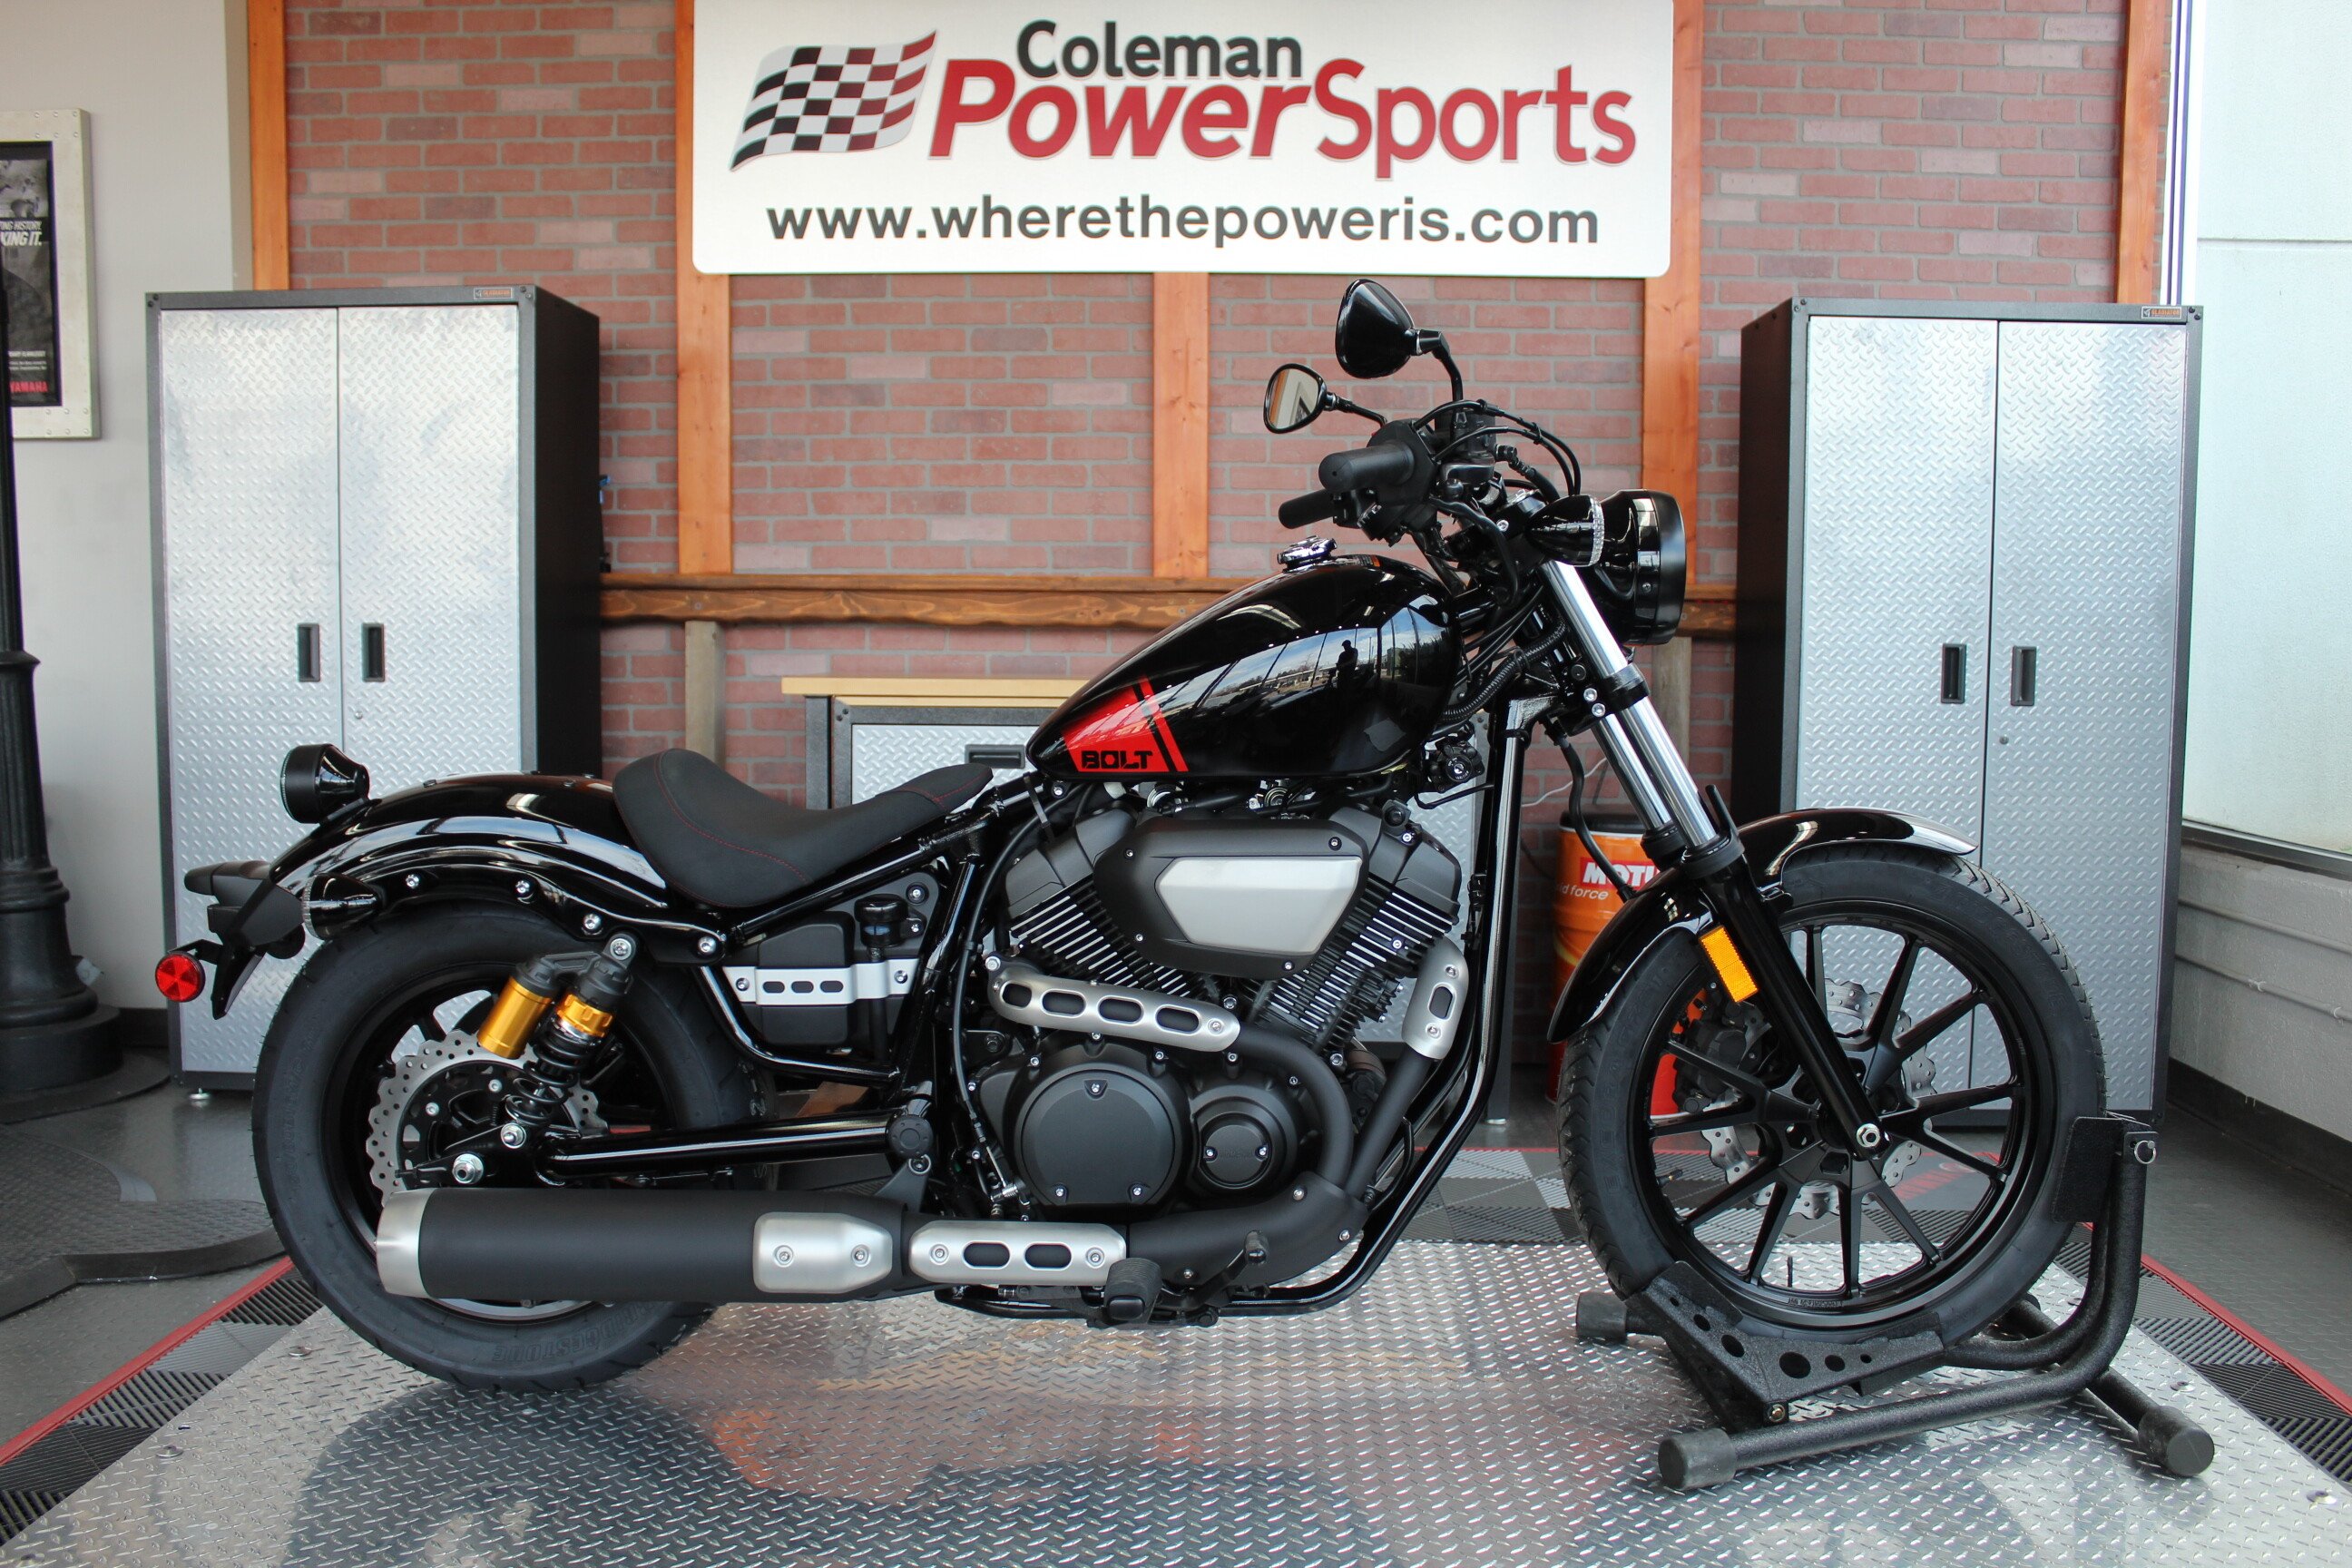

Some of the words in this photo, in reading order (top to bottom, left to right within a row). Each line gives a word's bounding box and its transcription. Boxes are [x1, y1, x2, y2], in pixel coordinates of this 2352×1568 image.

[1016, 21, 1303, 80] Coleman
[929, 57, 1636, 181] PowerSports
[766, 194, 1601, 249] www.wherethepoweris.com
[1081, 750, 1153, 769] BOLT
[1570, 884, 1610, 901] force
